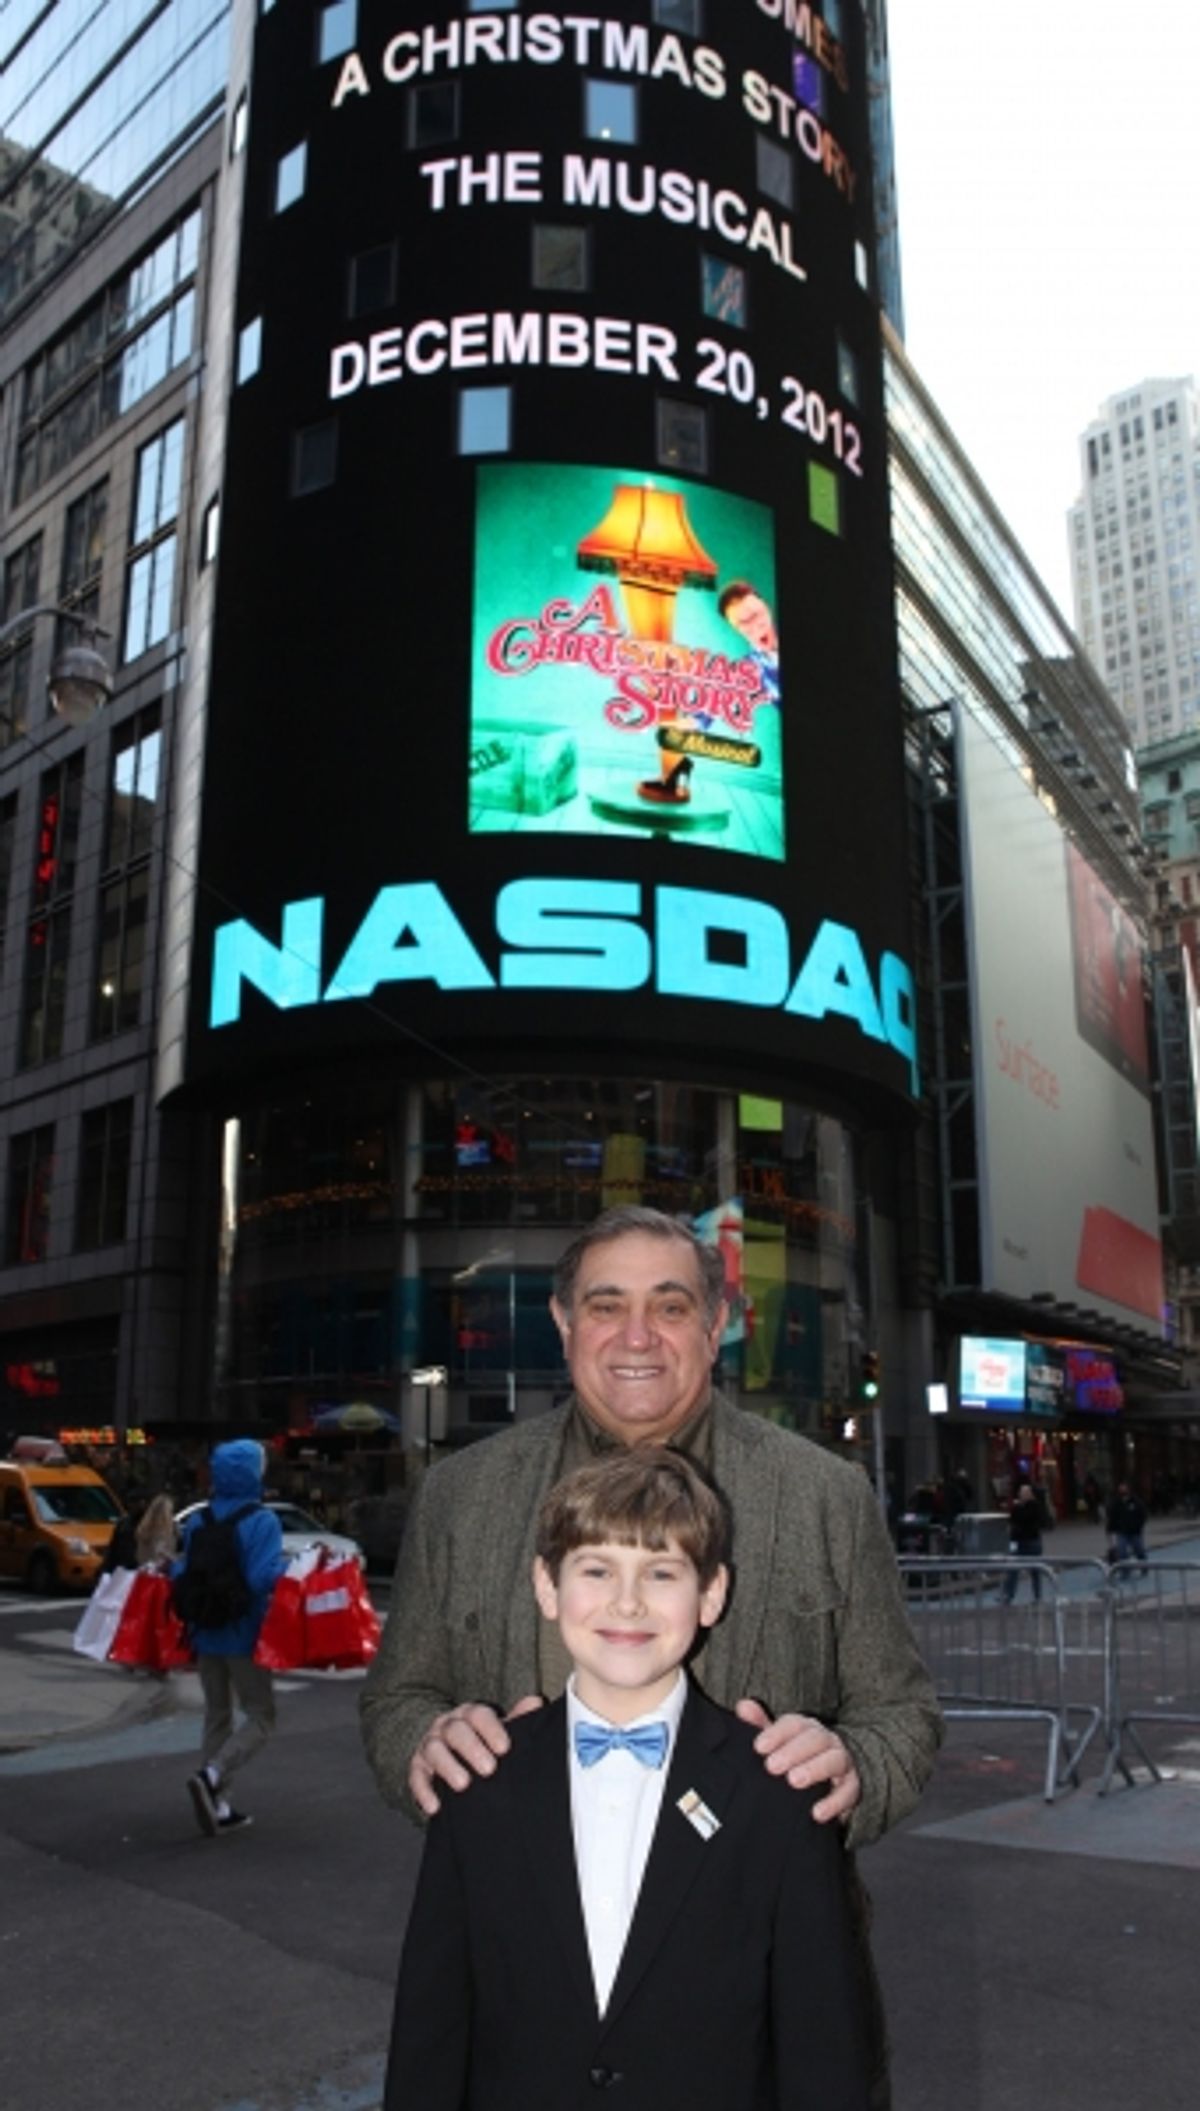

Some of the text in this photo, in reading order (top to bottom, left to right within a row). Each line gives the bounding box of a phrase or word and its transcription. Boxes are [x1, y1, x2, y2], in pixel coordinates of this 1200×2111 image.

[332, 14, 856, 205] A CHRISTMAS STORY
[421, 153, 807, 281] THE MUSICAL
[329, 313, 863, 476] DECEMBER 20, 2012
[209, 878, 919, 1099] NASDAQ
